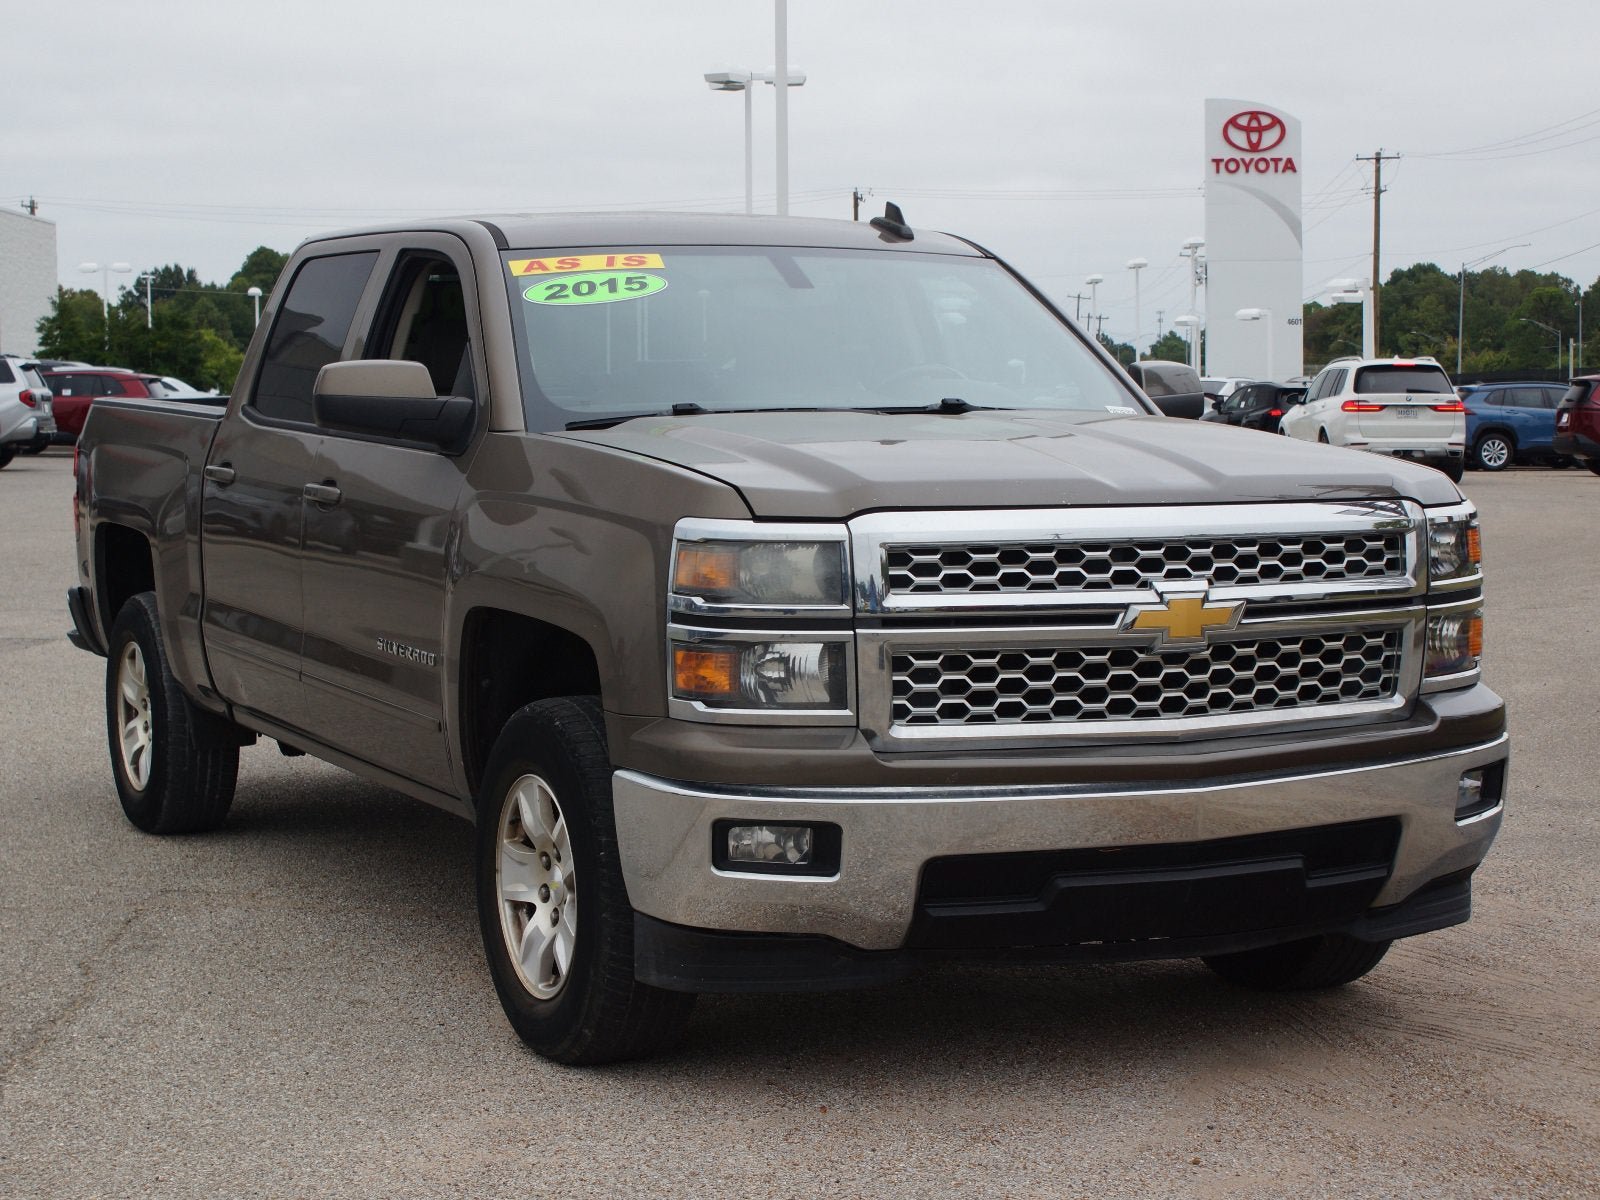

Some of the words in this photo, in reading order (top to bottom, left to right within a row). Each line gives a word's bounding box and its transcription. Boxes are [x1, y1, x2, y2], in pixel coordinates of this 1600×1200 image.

[1211, 157, 1297, 174] TOYOTA
[523, 257, 581, 273] AS
[606, 255, 648, 268] IS
[544, 275, 649, 301] 2015
[376, 637, 436, 666] SILVERADO
